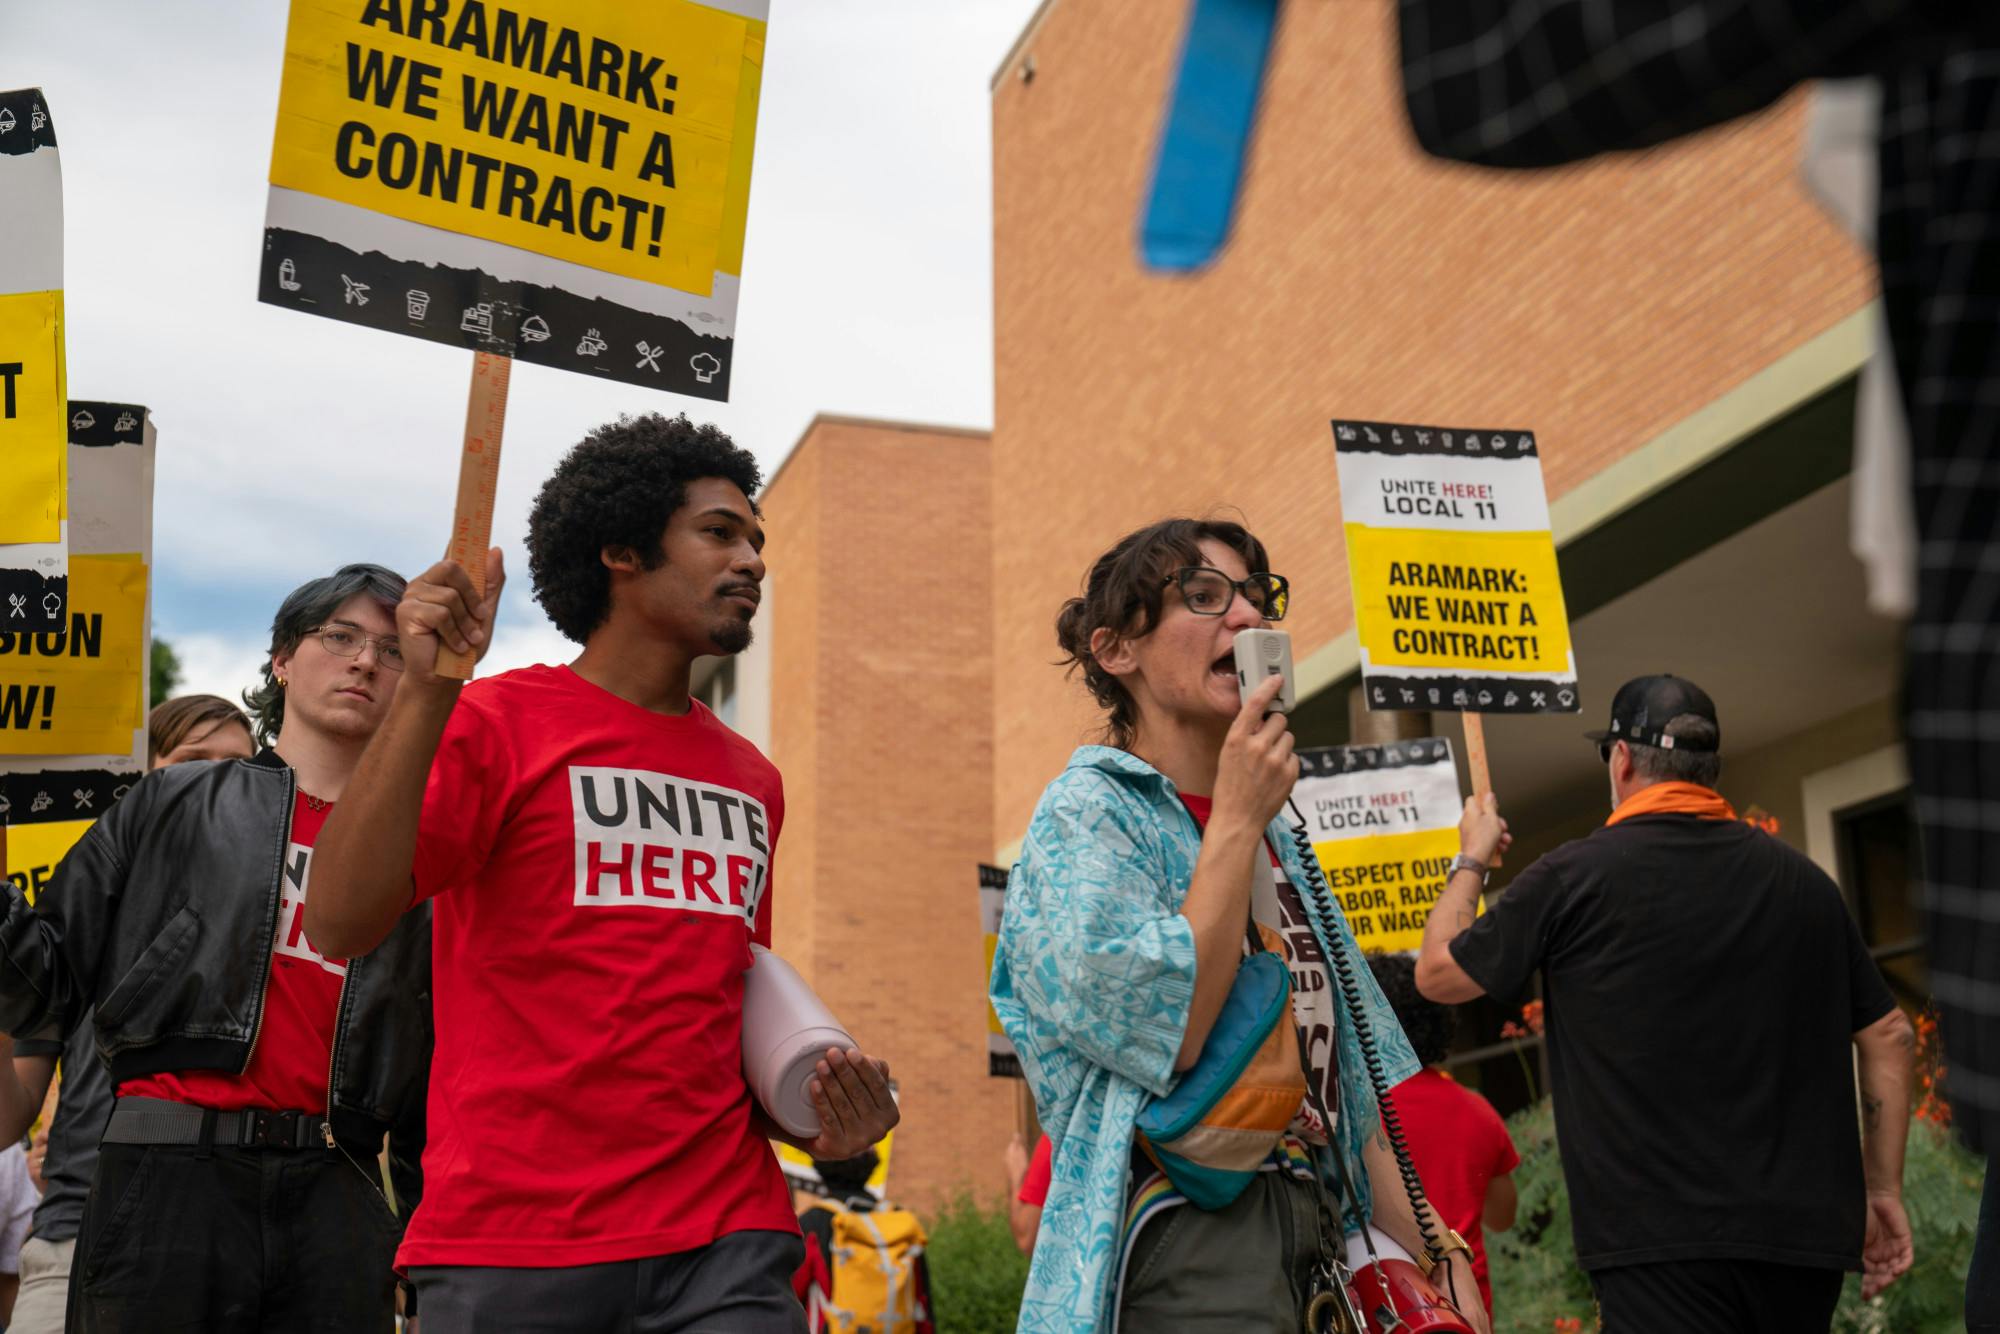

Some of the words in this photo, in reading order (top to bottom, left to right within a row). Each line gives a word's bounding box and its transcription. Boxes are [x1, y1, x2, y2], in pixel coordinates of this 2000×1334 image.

[346, 42, 443, 121] WE
[462, 73, 629, 171] WANT
[637, 131, 676, 188] A
[335, 120, 666, 257] CONTRACT!
[1381, 479, 1437, 496] UNITE
[1442, 482, 1494, 499] HERE!
[1383, 496, 1463, 518] LOCAL
[1474, 502, 1497, 519] 11
[1389, 562, 1528, 593] ARAMARK:
[1387, 595, 1430, 621] WE
[1436, 597, 1509, 626] WANT
[1519, 602, 1538, 626] A
[1393, 629, 1540, 660] CONTRACT!
[580, 775, 767, 856] UNITE
[1315, 794, 1365, 813] UNITE
[1369, 790, 1414, 807] HERE!
[1318, 809, 1390, 831] LOCAL
[1398, 806, 1419, 822] 11
[1322, 861, 1405, 889] ESPECT
